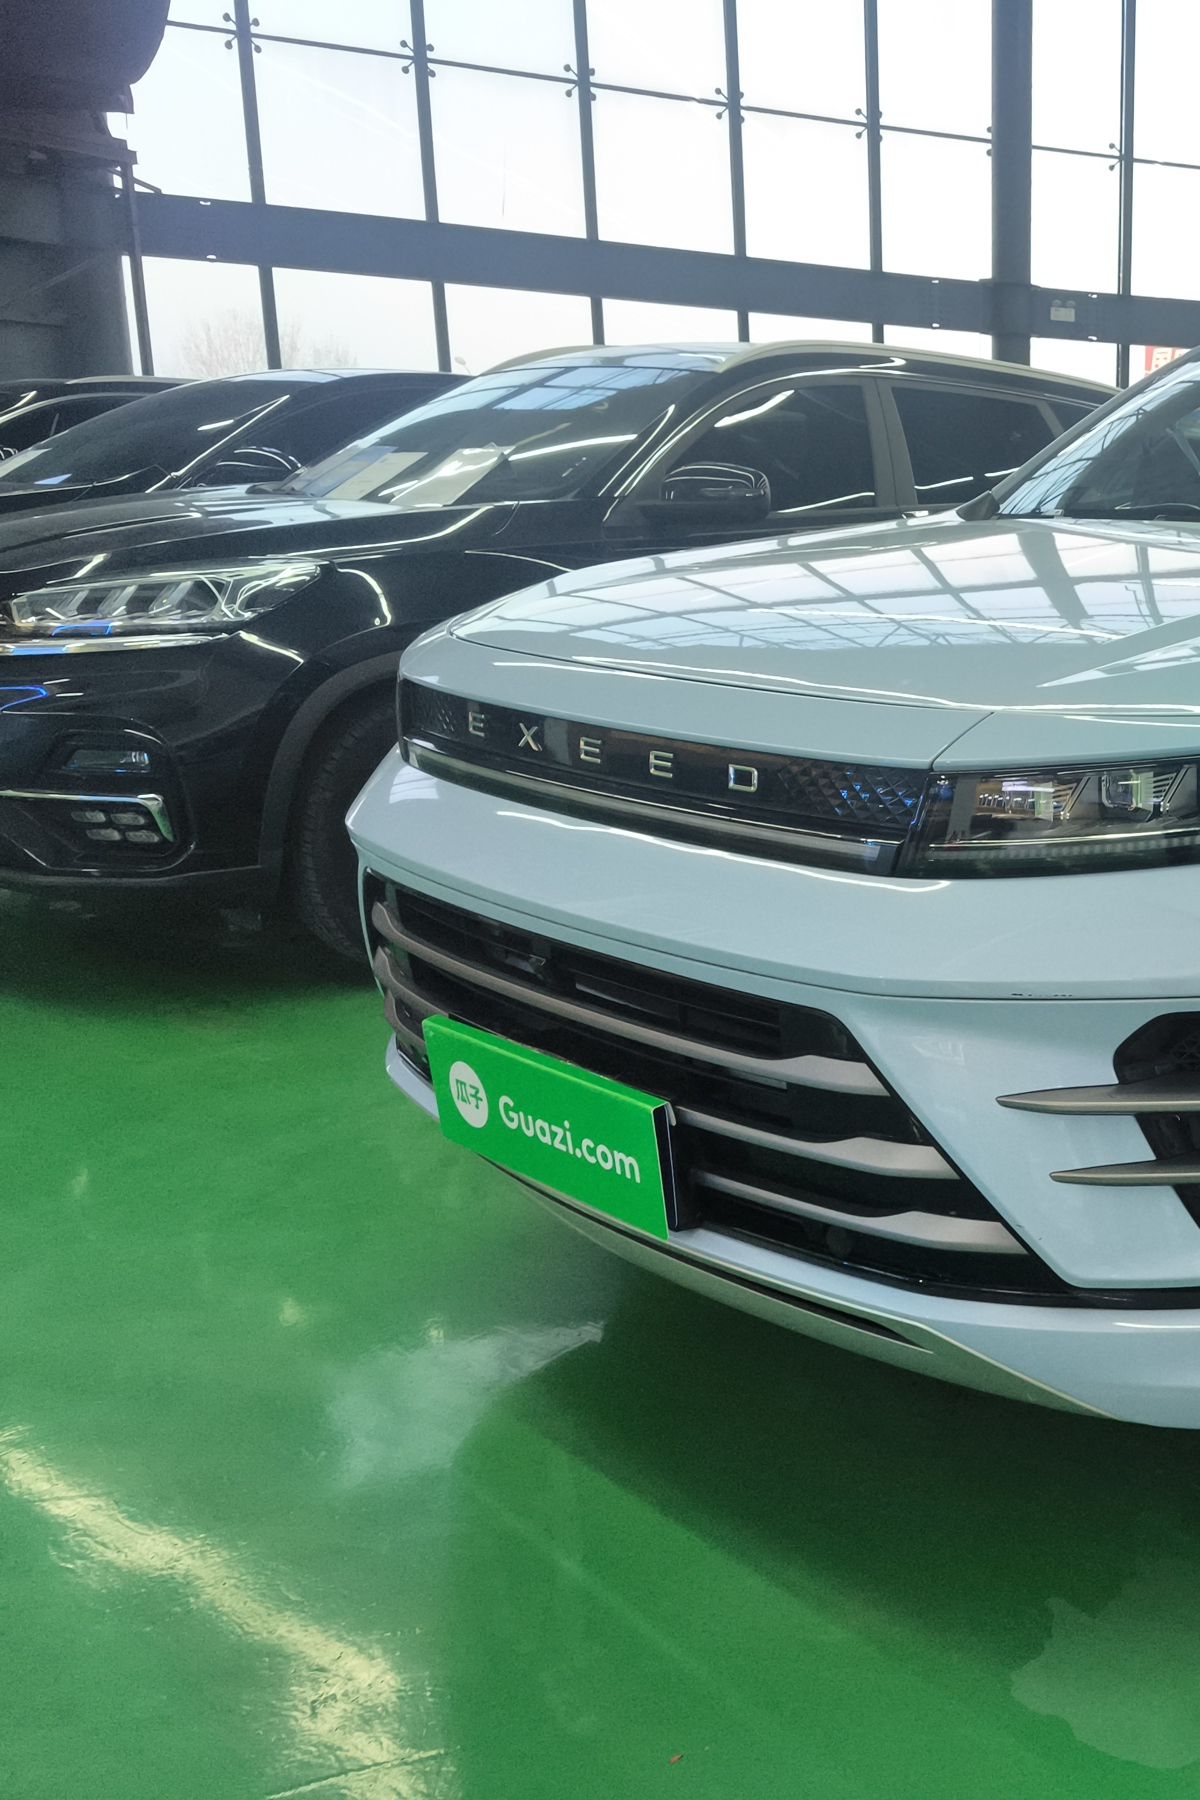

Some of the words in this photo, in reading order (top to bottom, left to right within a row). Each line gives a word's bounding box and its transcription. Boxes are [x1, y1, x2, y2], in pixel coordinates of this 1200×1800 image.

[468, 711, 758, 792] EXEED
[455, 1078, 483, 1110] 瓜子
[499, 1095, 641, 1183] Guazi.com
